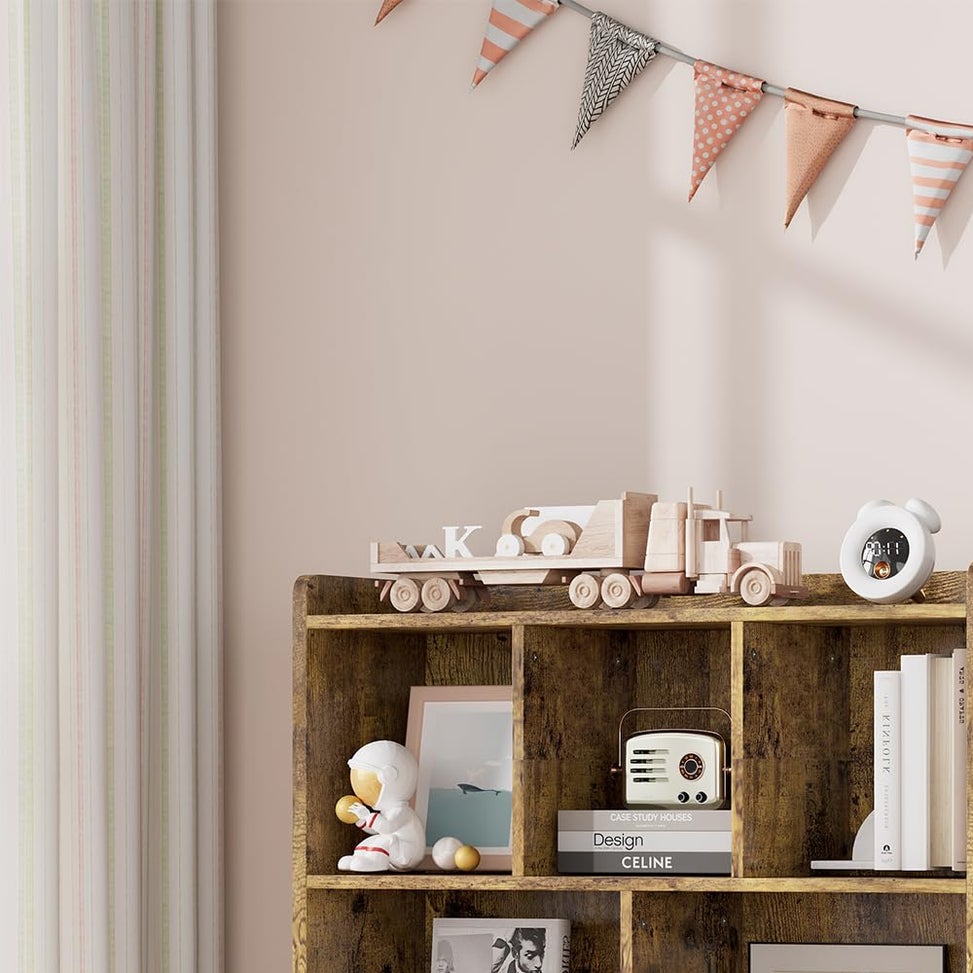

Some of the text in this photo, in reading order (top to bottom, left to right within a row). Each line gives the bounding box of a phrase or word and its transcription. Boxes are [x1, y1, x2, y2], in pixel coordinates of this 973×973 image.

[610, 813, 693, 822] CASE STUDY HOUSES
[593, 833, 644, 851] Design
[621, 856, 673, 869] CELINE
